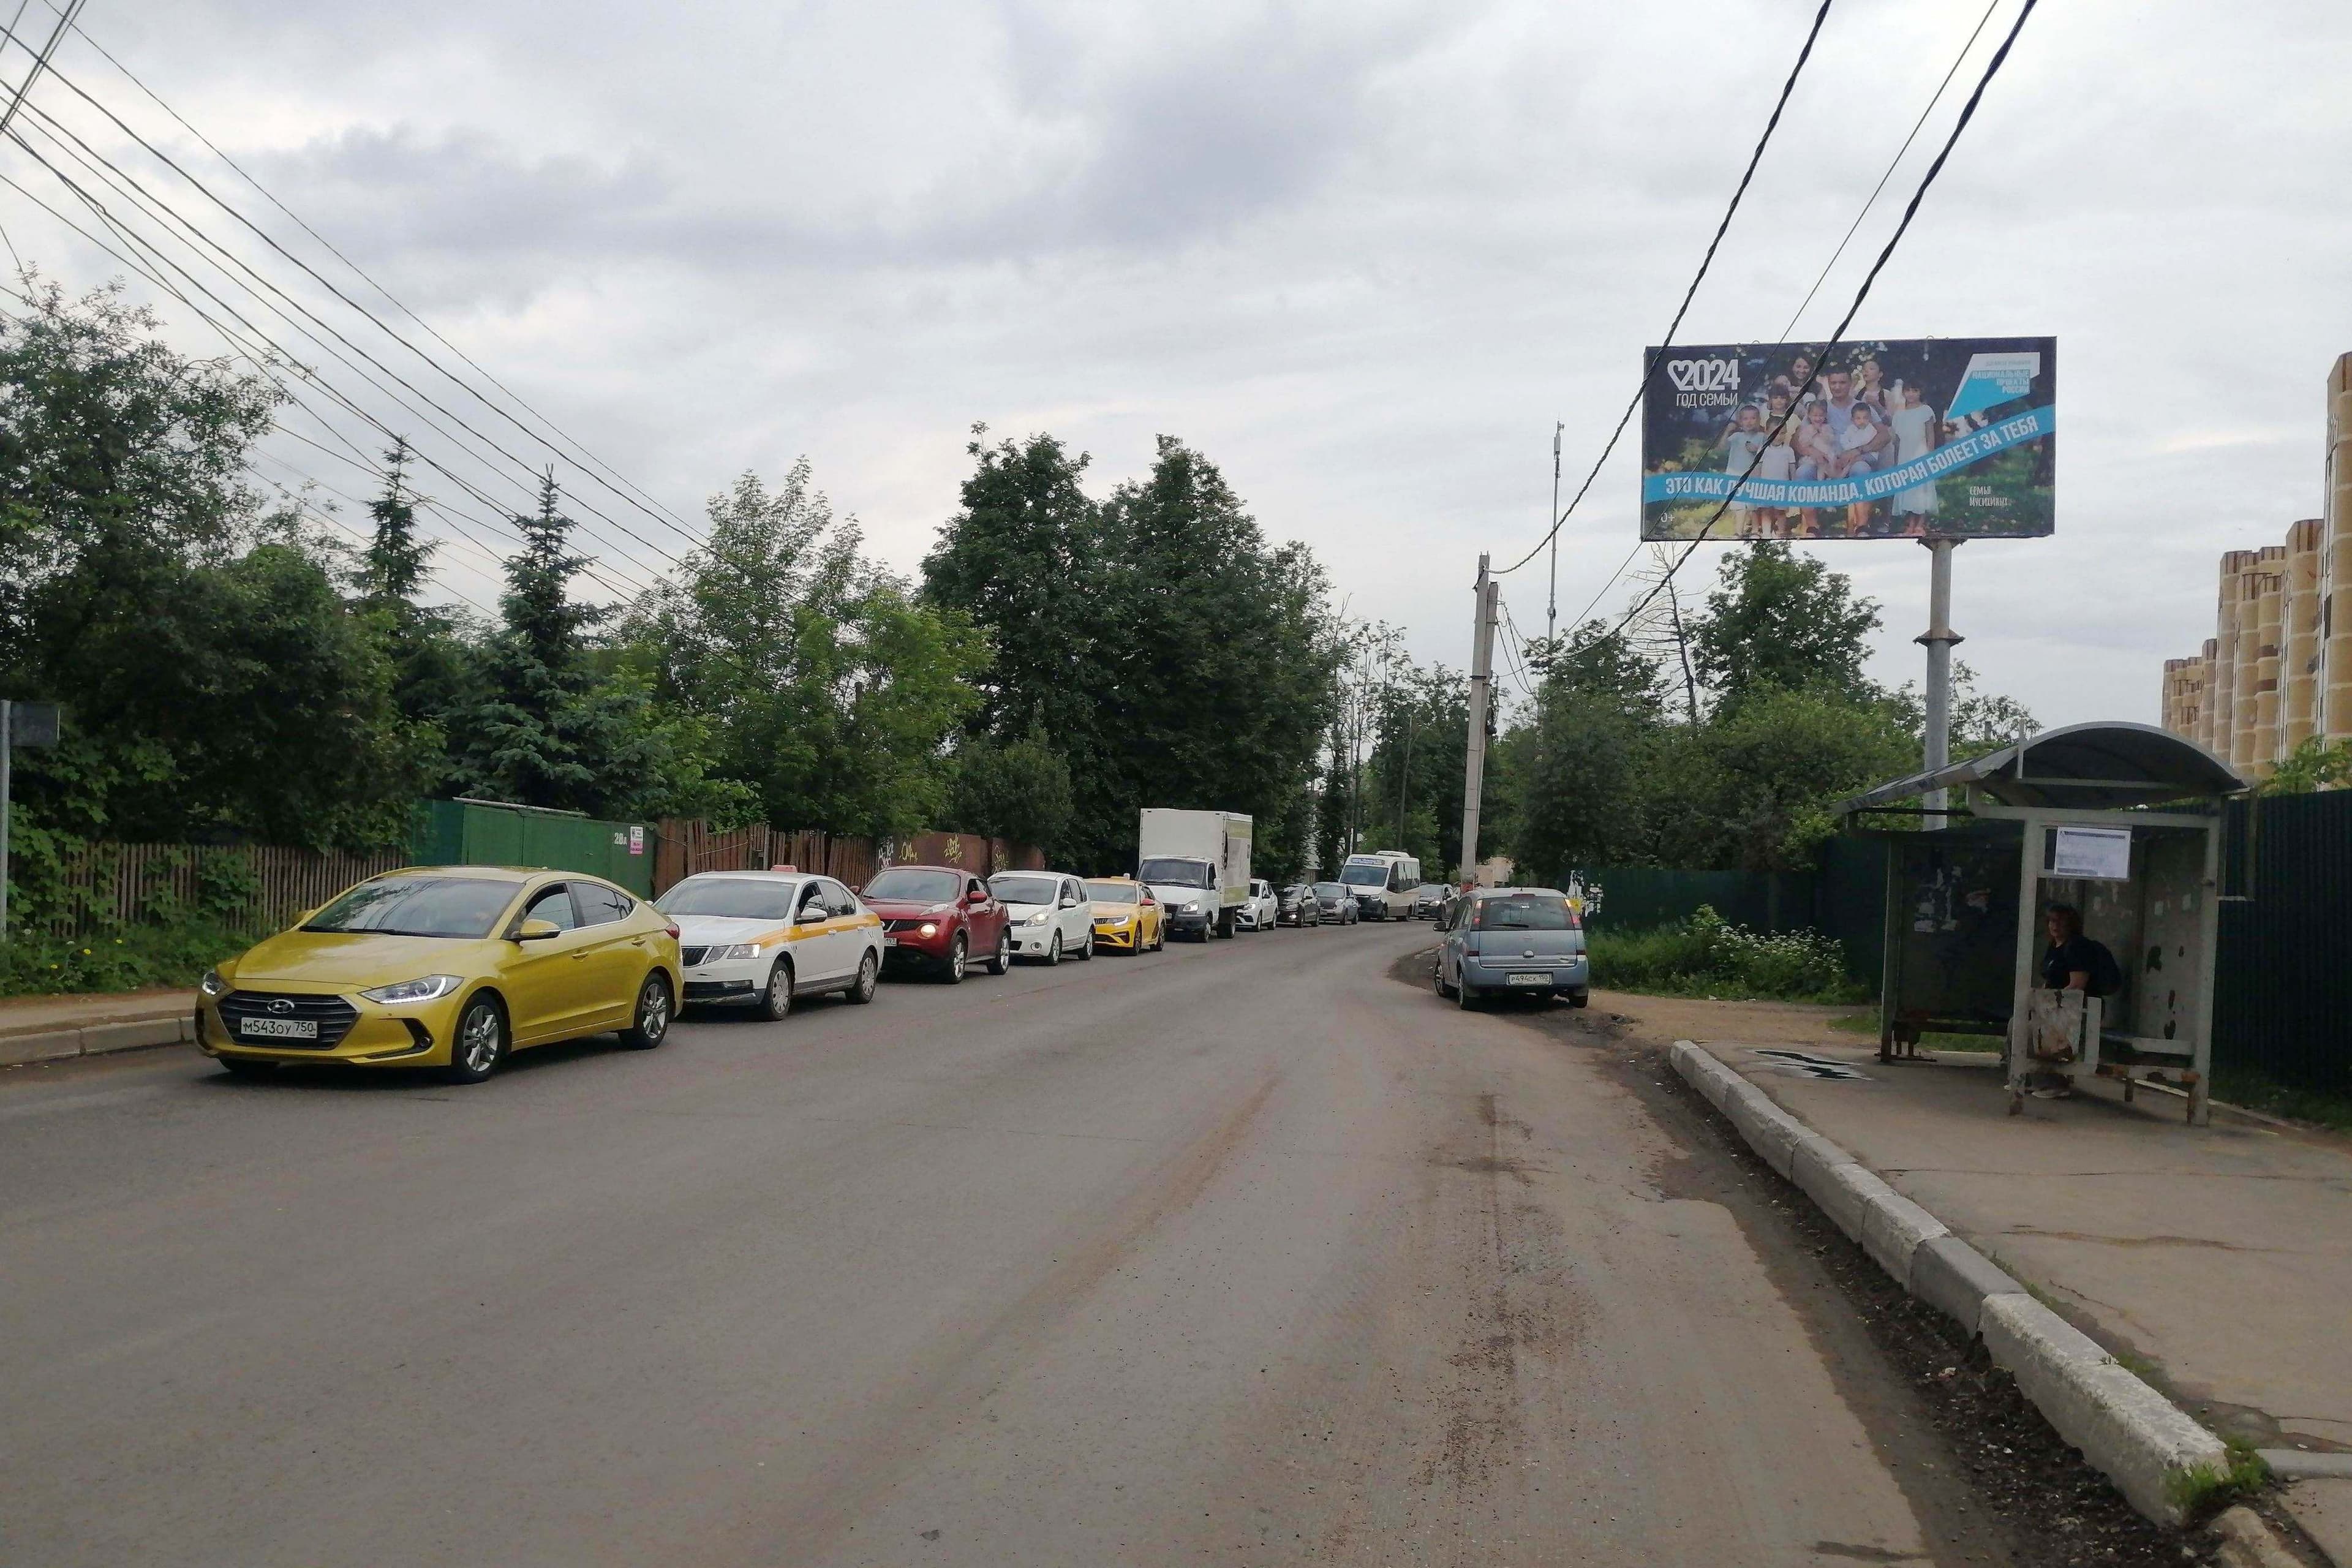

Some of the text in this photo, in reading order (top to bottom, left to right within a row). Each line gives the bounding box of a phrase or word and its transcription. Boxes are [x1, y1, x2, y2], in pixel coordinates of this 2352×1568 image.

[1667, 359, 1741, 391] 2024
[1676, 393, 1697, 409] ГОД
[1665, 477, 1691, 494] ЭТО
[1695, 477, 1724, 495] КАК
[1787, 482, 1863, 503] КОМАНДА,
[1864, 462, 1928, 496] КОТОРАЯ
[1929, 438, 1980, 474] БОЛЕЕТ
[1980, 430, 2002, 450] ЗА
[1999, 415, 2039, 441] ТЕБЯ
[294, 1021, 314, 1032] 750
